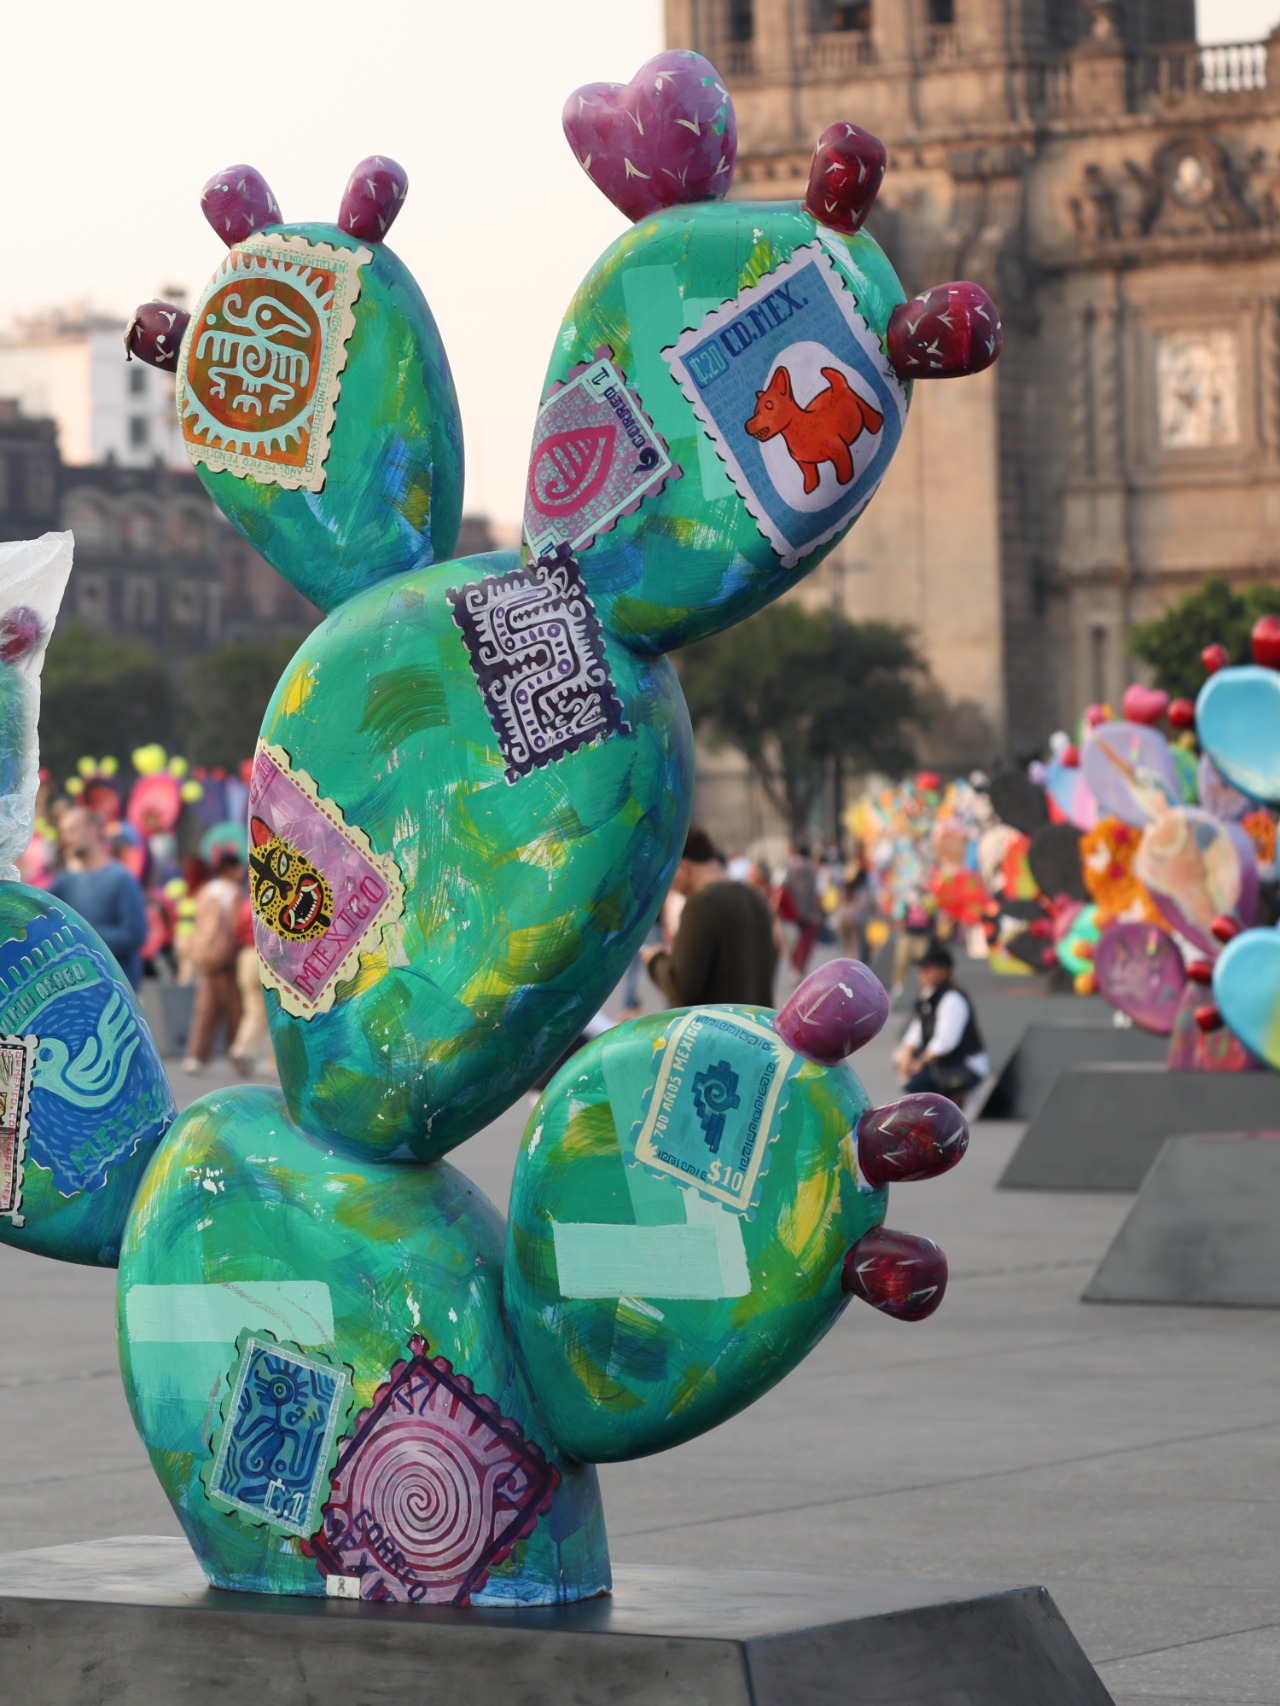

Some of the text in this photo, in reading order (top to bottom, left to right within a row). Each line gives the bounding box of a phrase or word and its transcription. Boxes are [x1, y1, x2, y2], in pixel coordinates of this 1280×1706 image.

[603, 385, 647, 450] CORREO
[305, 453, 315, 473] 700
[293, 873, 384, 999] MEXICO
[35, 961, 87, 1001] AEREO
[652, 1021, 704, 1139] 700 AÑOS MEXICO
[706, 1158, 743, 1192] $10
[353, 1508, 427, 1602] CORREO
